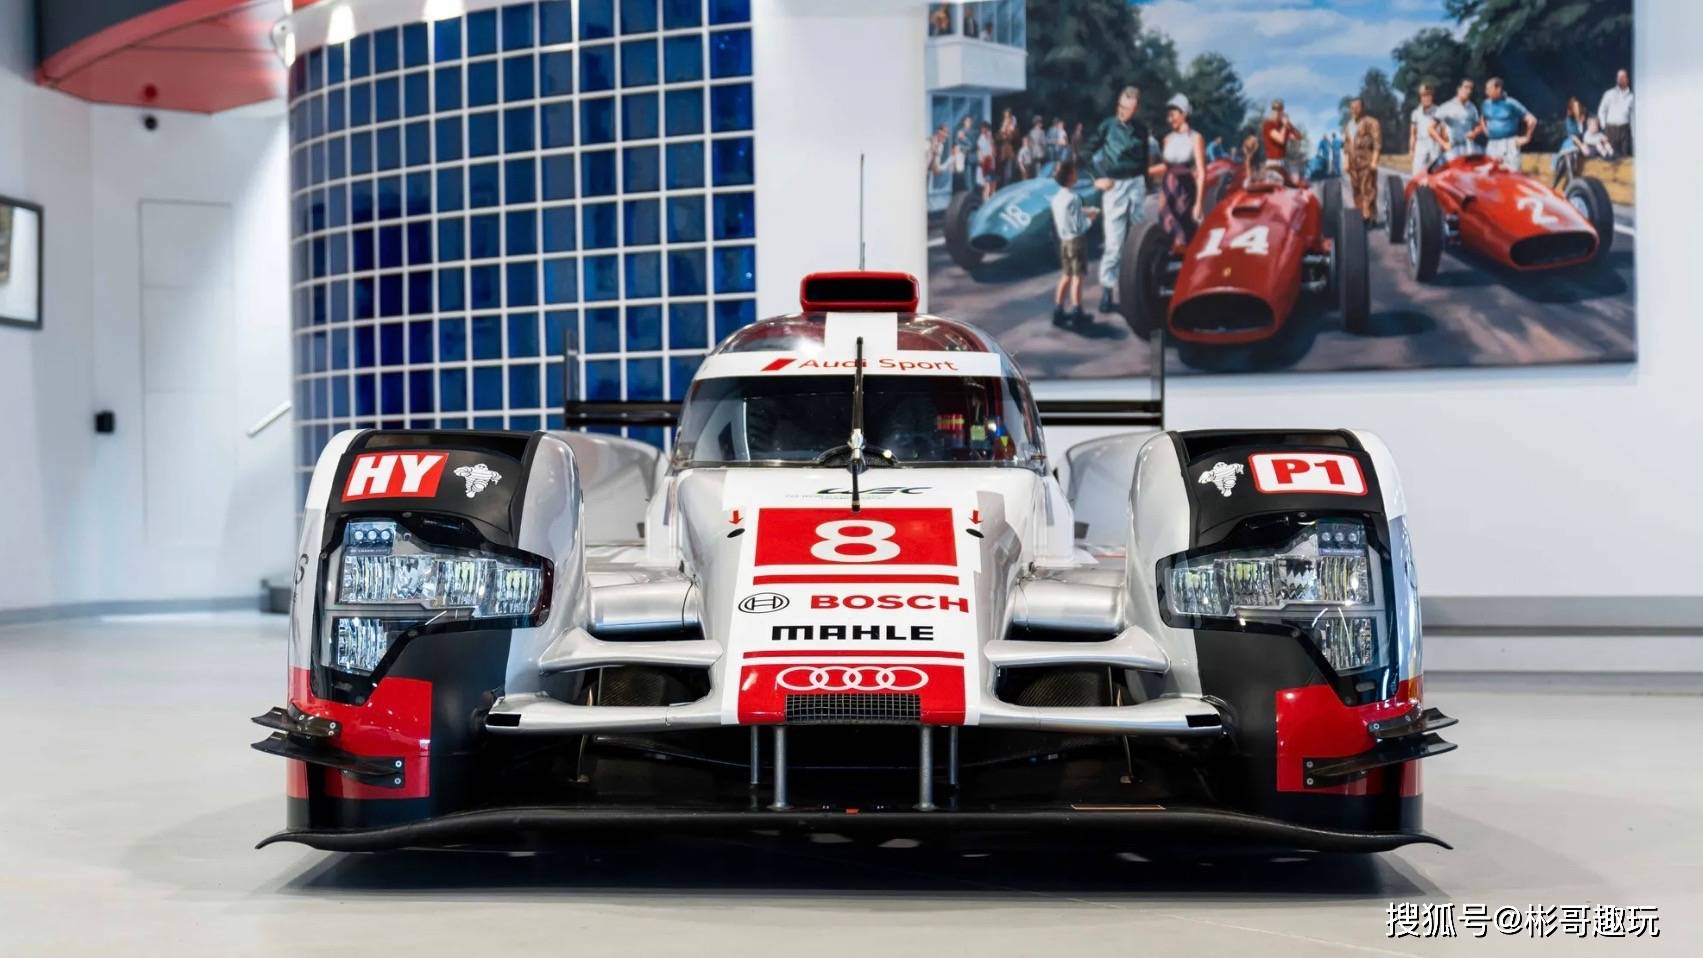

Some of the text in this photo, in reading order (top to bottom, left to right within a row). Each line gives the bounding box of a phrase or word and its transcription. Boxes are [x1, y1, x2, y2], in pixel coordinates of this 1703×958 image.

[1196, 225, 1269, 259] 14
[799, 359, 959, 371] Audi Sport
[345, 454, 444, 497] HY
[1271, 459, 1346, 486] P1
[810, 519, 901, 563] 8
[810, 594, 969, 613] BOSCH
[771, 625, 934, 641] MAHLE
